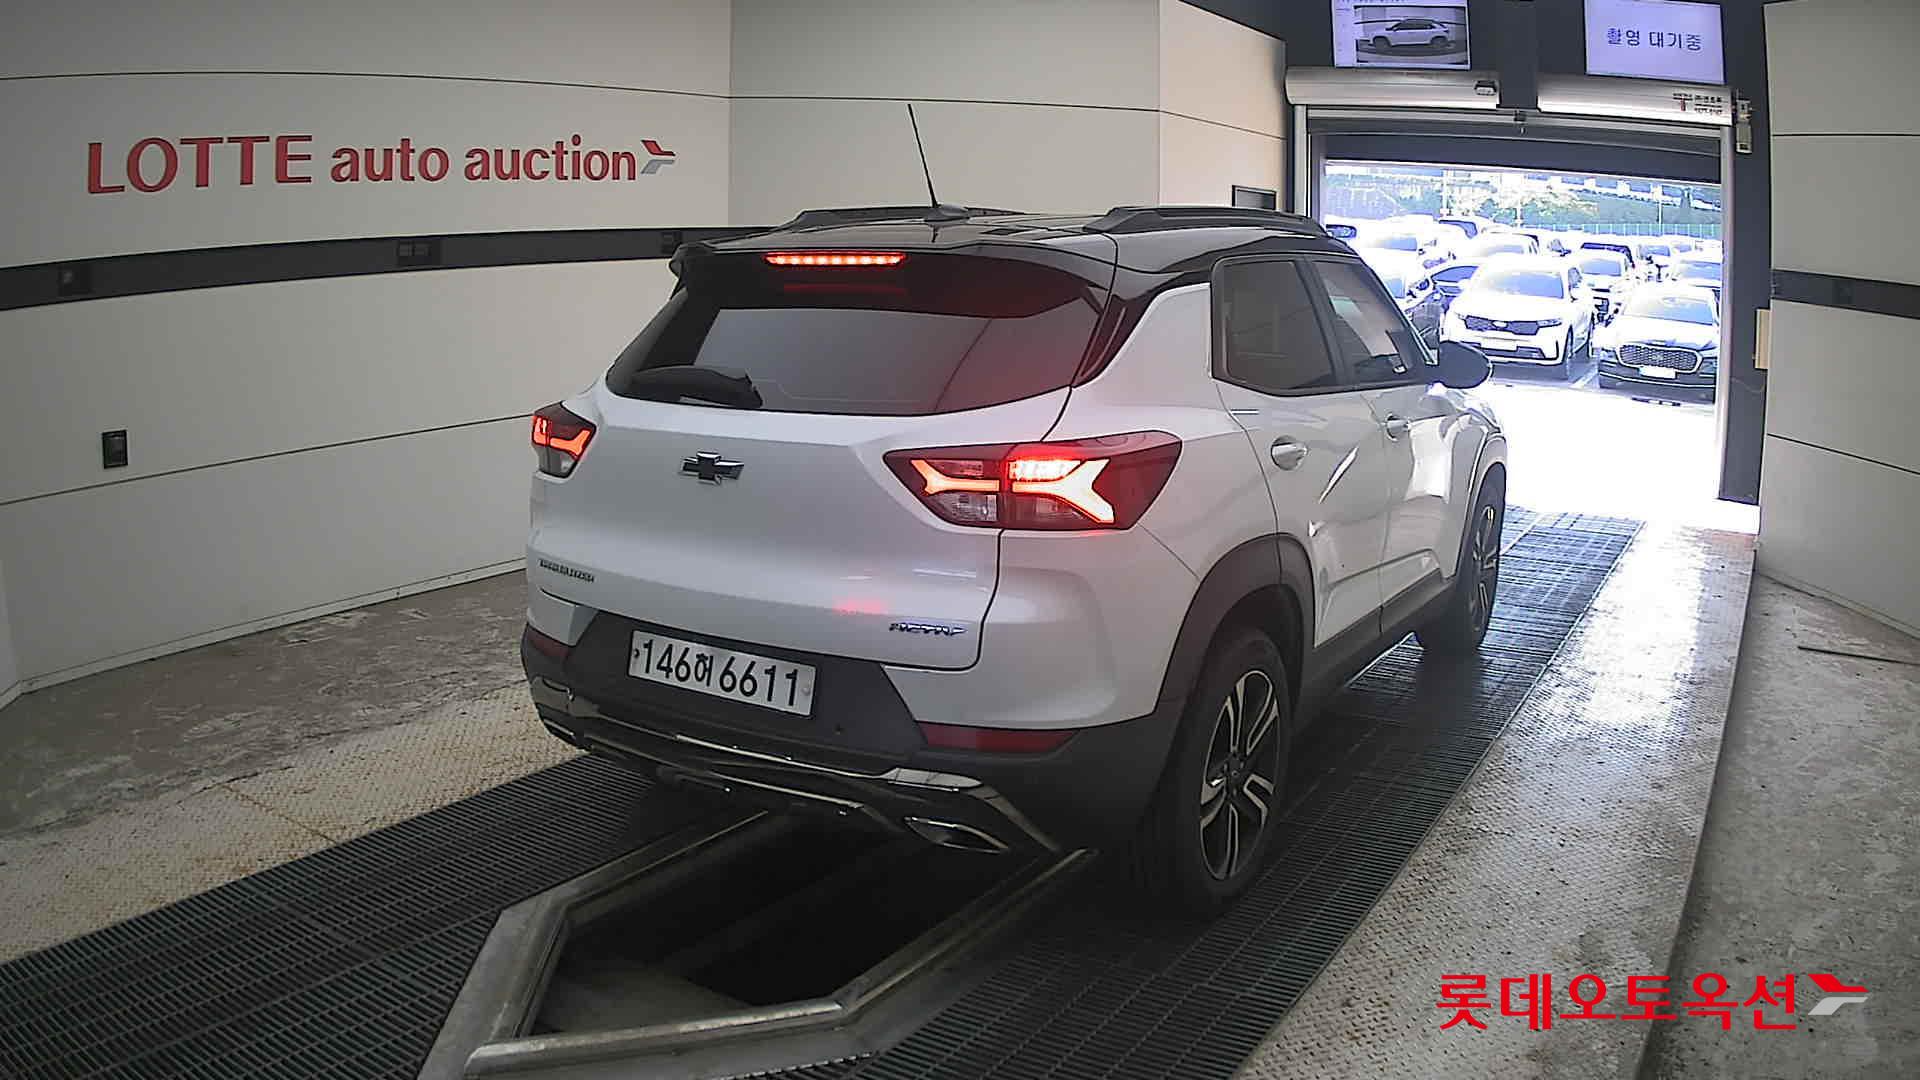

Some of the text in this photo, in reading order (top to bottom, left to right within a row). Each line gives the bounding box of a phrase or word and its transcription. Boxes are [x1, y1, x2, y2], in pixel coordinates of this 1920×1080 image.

[1647, 31, 1702, 51] 대기중
[87, 133, 637, 194] LOTTE auto auction
